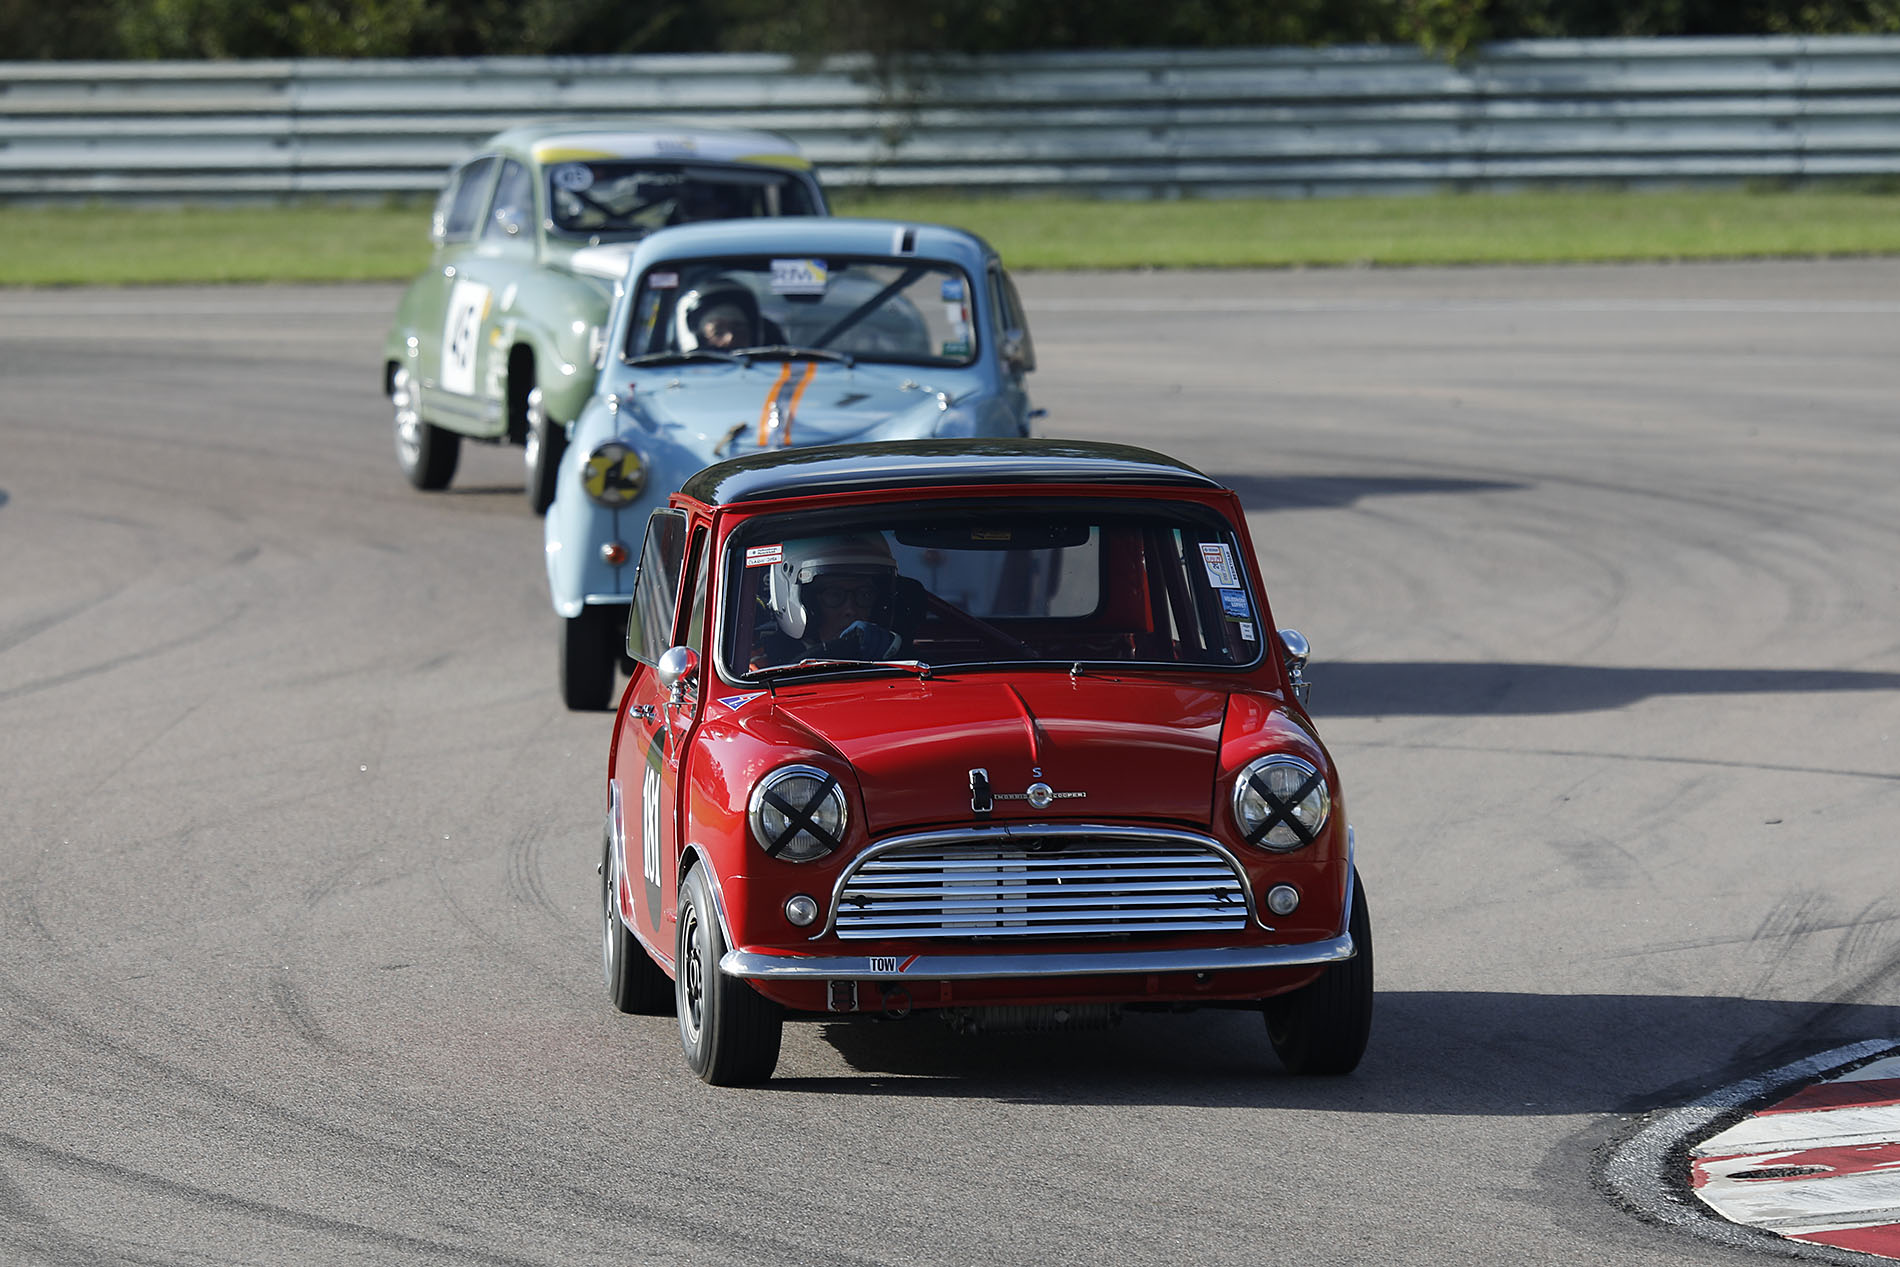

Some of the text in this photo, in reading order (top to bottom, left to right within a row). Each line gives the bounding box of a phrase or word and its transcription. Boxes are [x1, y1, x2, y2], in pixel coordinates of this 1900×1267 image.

[1032, 767, 1042, 778] S
[1053, 791, 1084, 799] COOPER
[643, 766, 661, 888] 181
[871, 958, 895, 972] TOW
